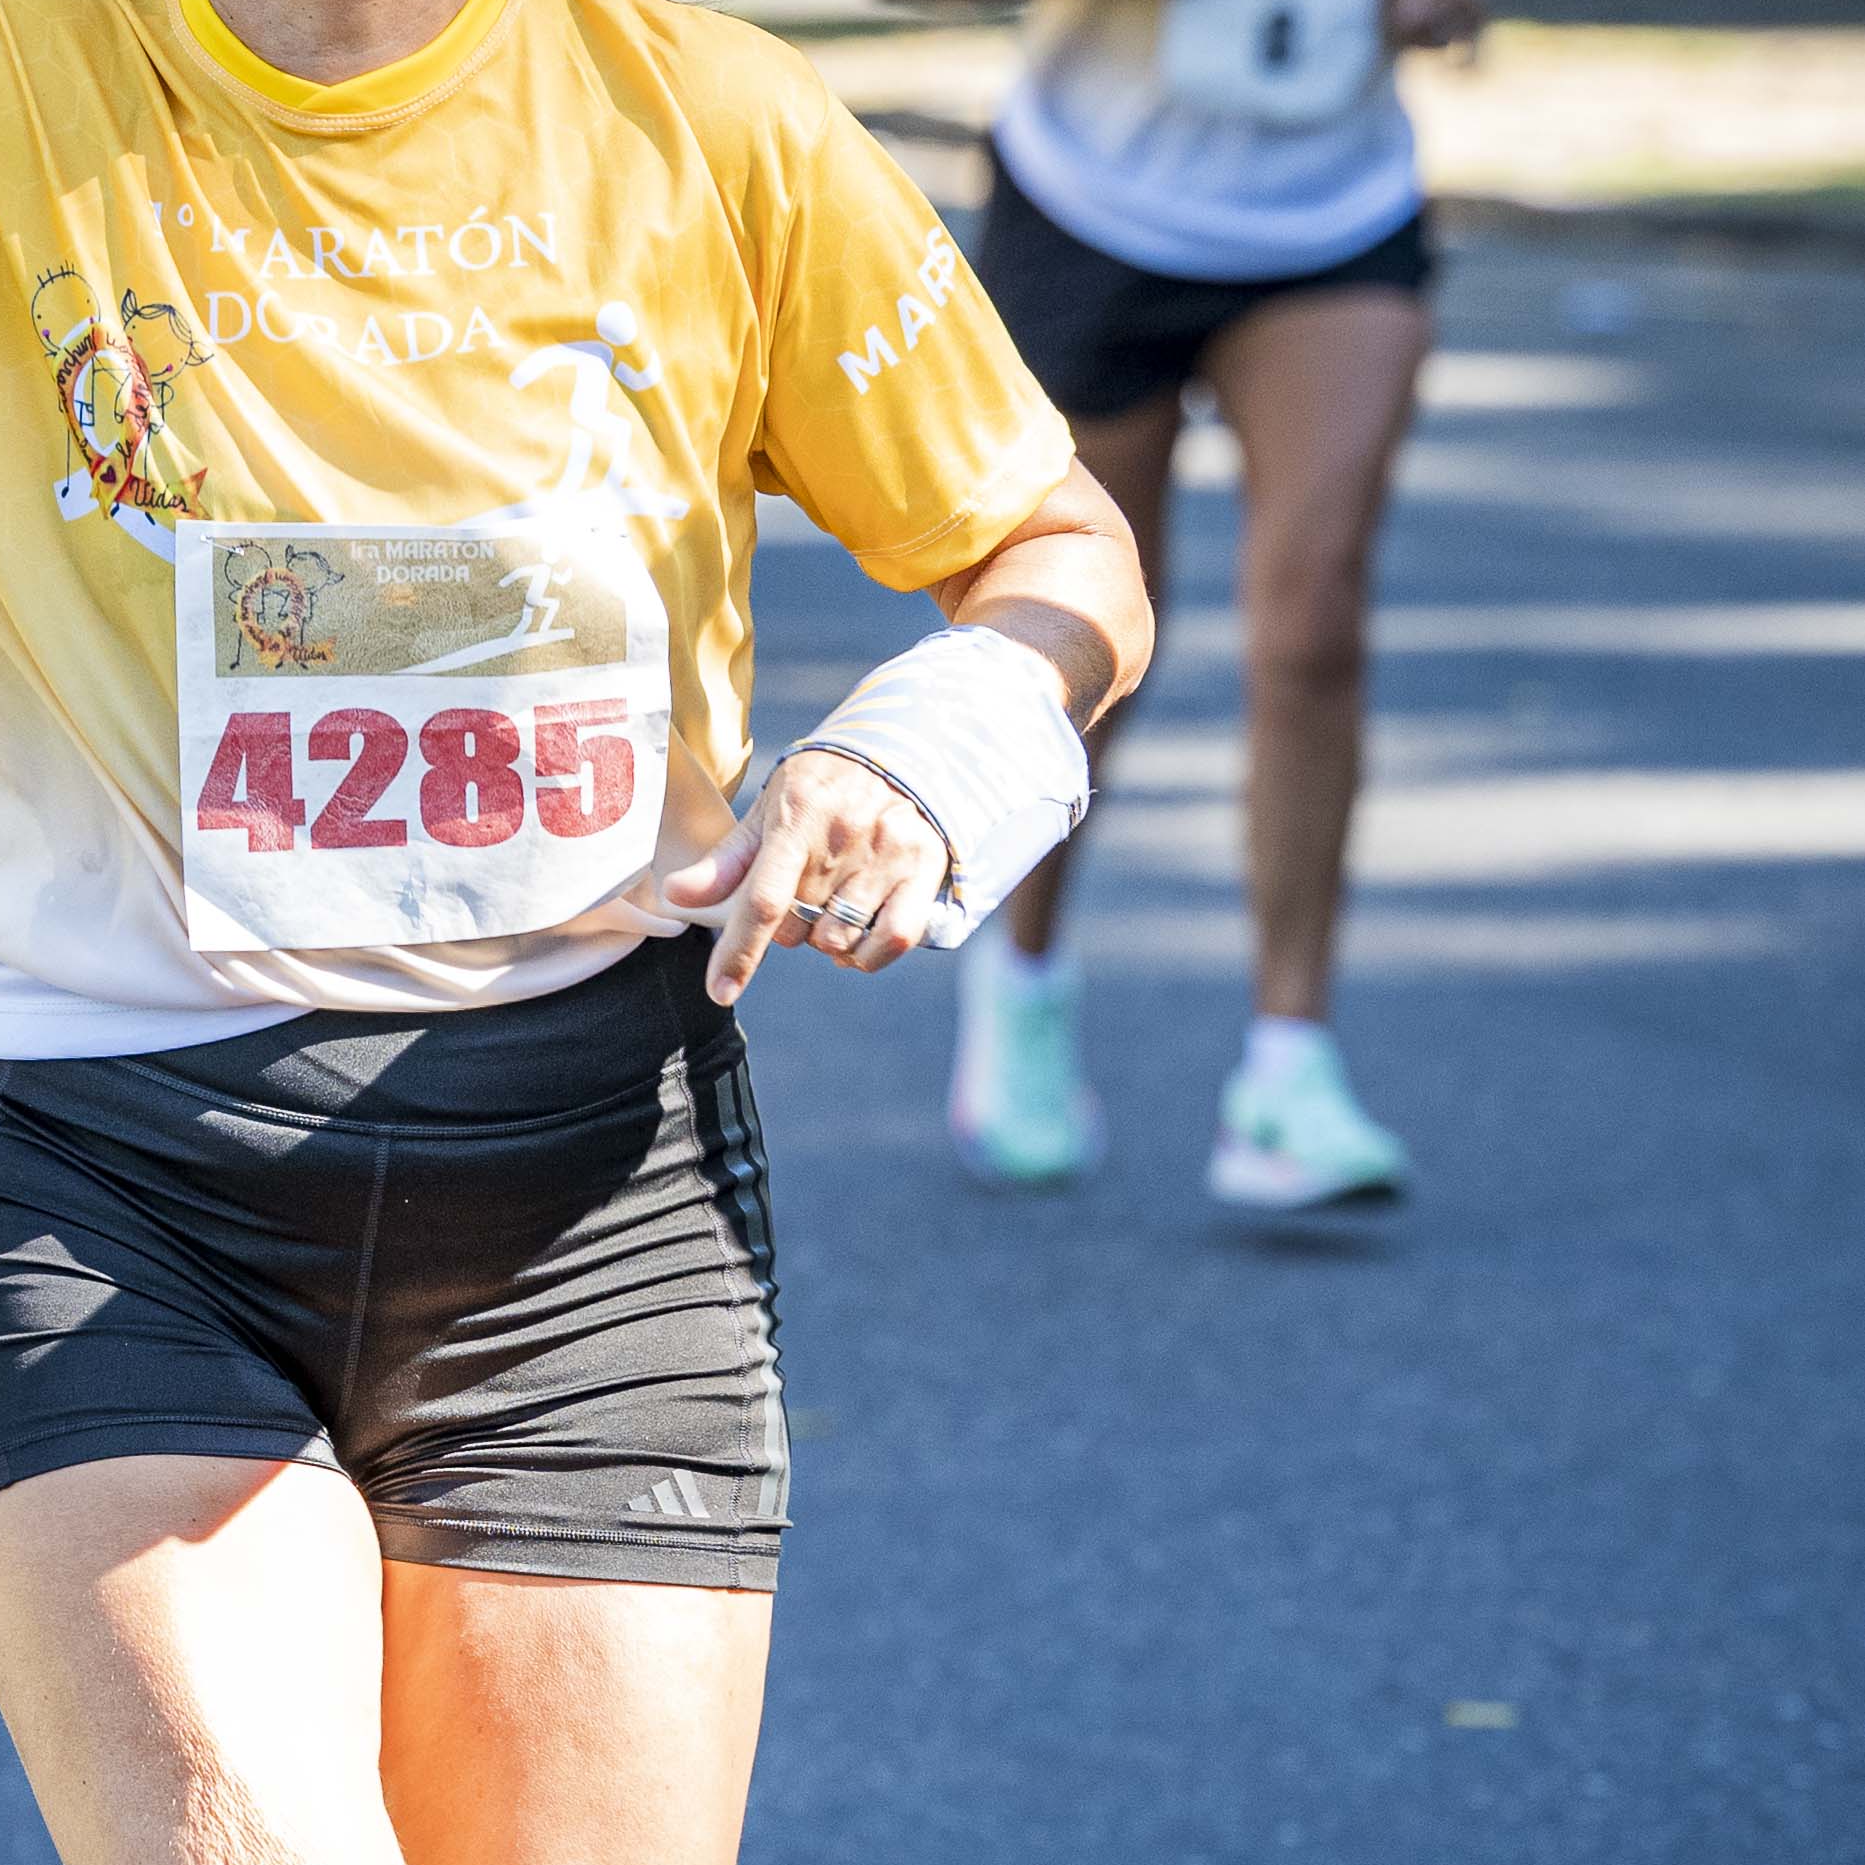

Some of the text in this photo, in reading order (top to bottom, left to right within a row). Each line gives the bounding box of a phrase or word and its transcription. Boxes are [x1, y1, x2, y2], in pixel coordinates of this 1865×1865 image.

[205, 289, 509, 366] DORADA
[376, 565, 471, 584] DORADA
[197, 698, 634, 853] 4285
